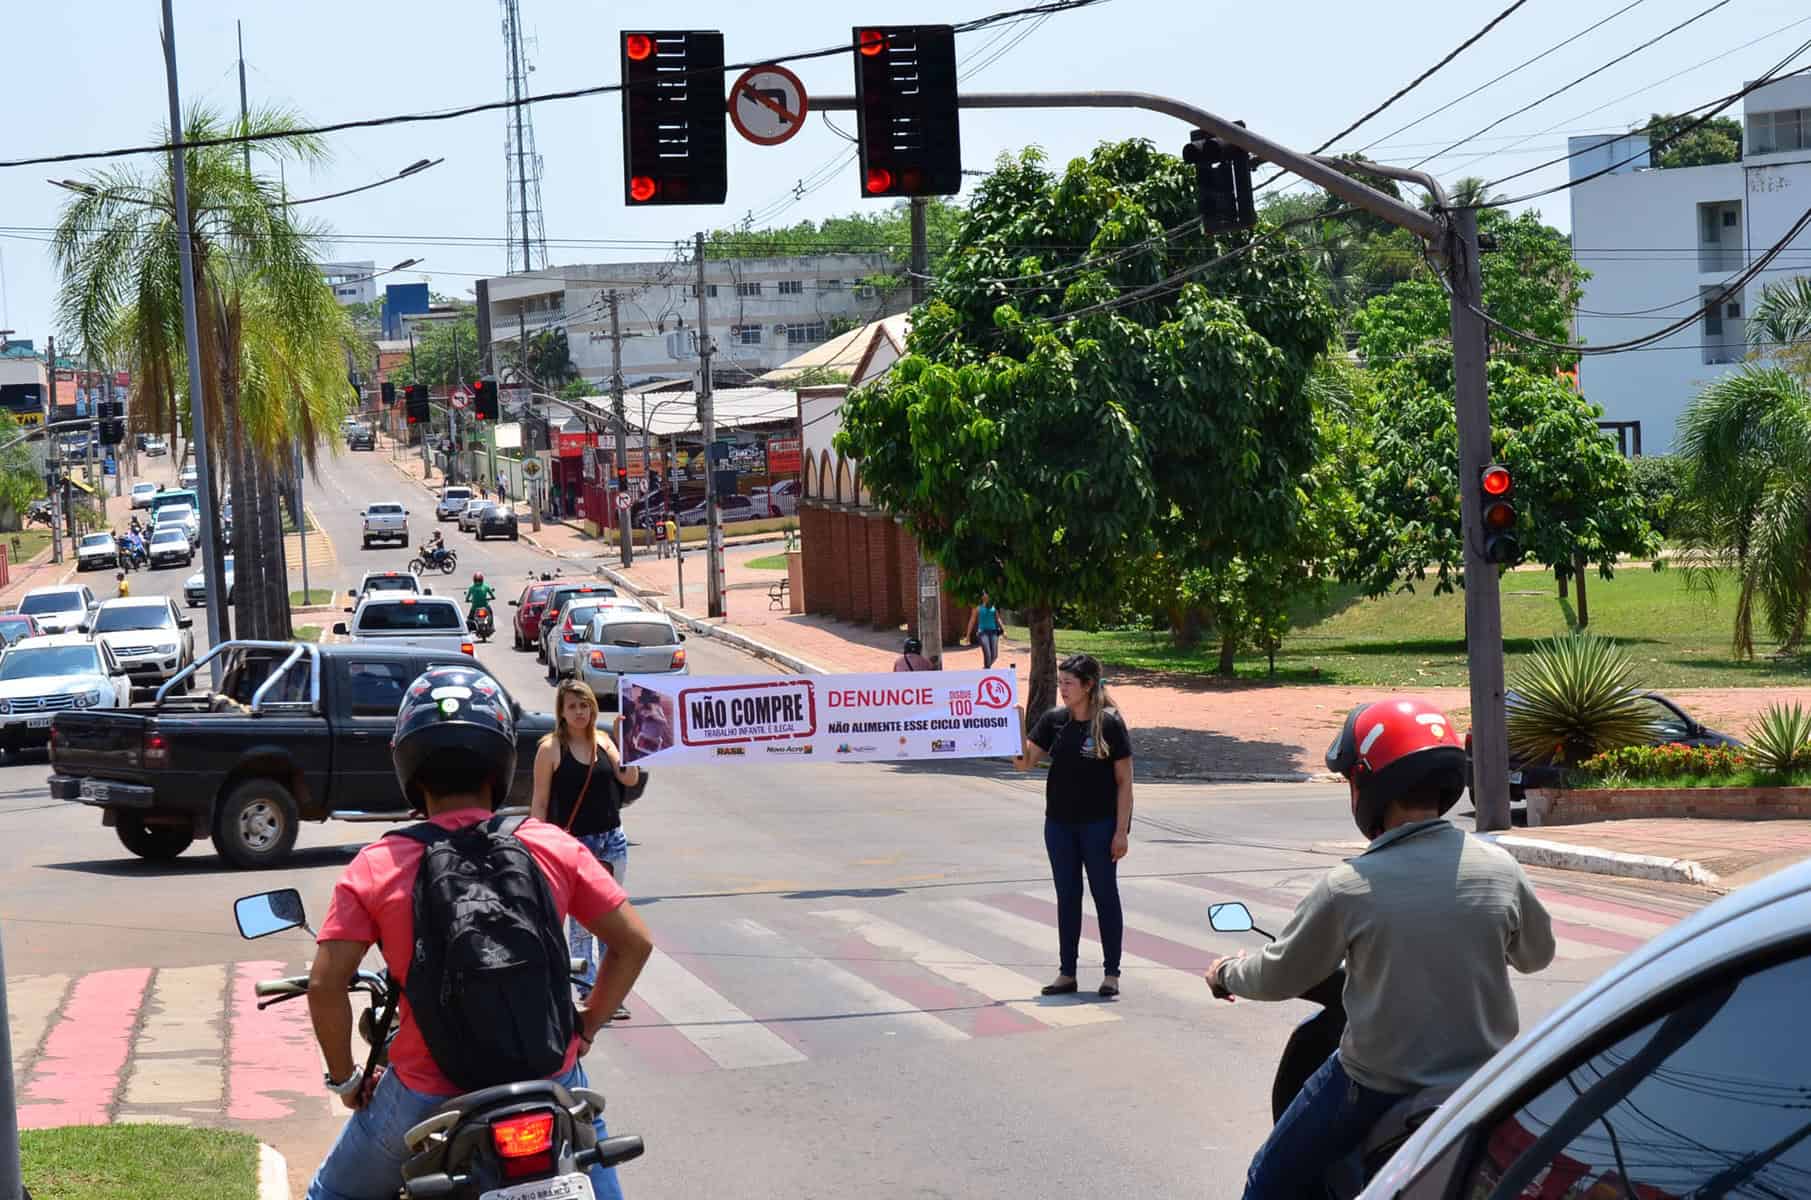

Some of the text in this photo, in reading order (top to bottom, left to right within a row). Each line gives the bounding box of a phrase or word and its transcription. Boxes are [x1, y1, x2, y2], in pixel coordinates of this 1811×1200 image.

[828, 688, 934, 707] DENUNCIE
[691, 694, 804, 730] NÃO COMPRE
[949, 699, 973, 716] 100
[704, 728, 737, 737] TRABALHO
[828, 717, 1008, 734] NÃO ALIMENTE ESSE CICLO VICIOSO!
